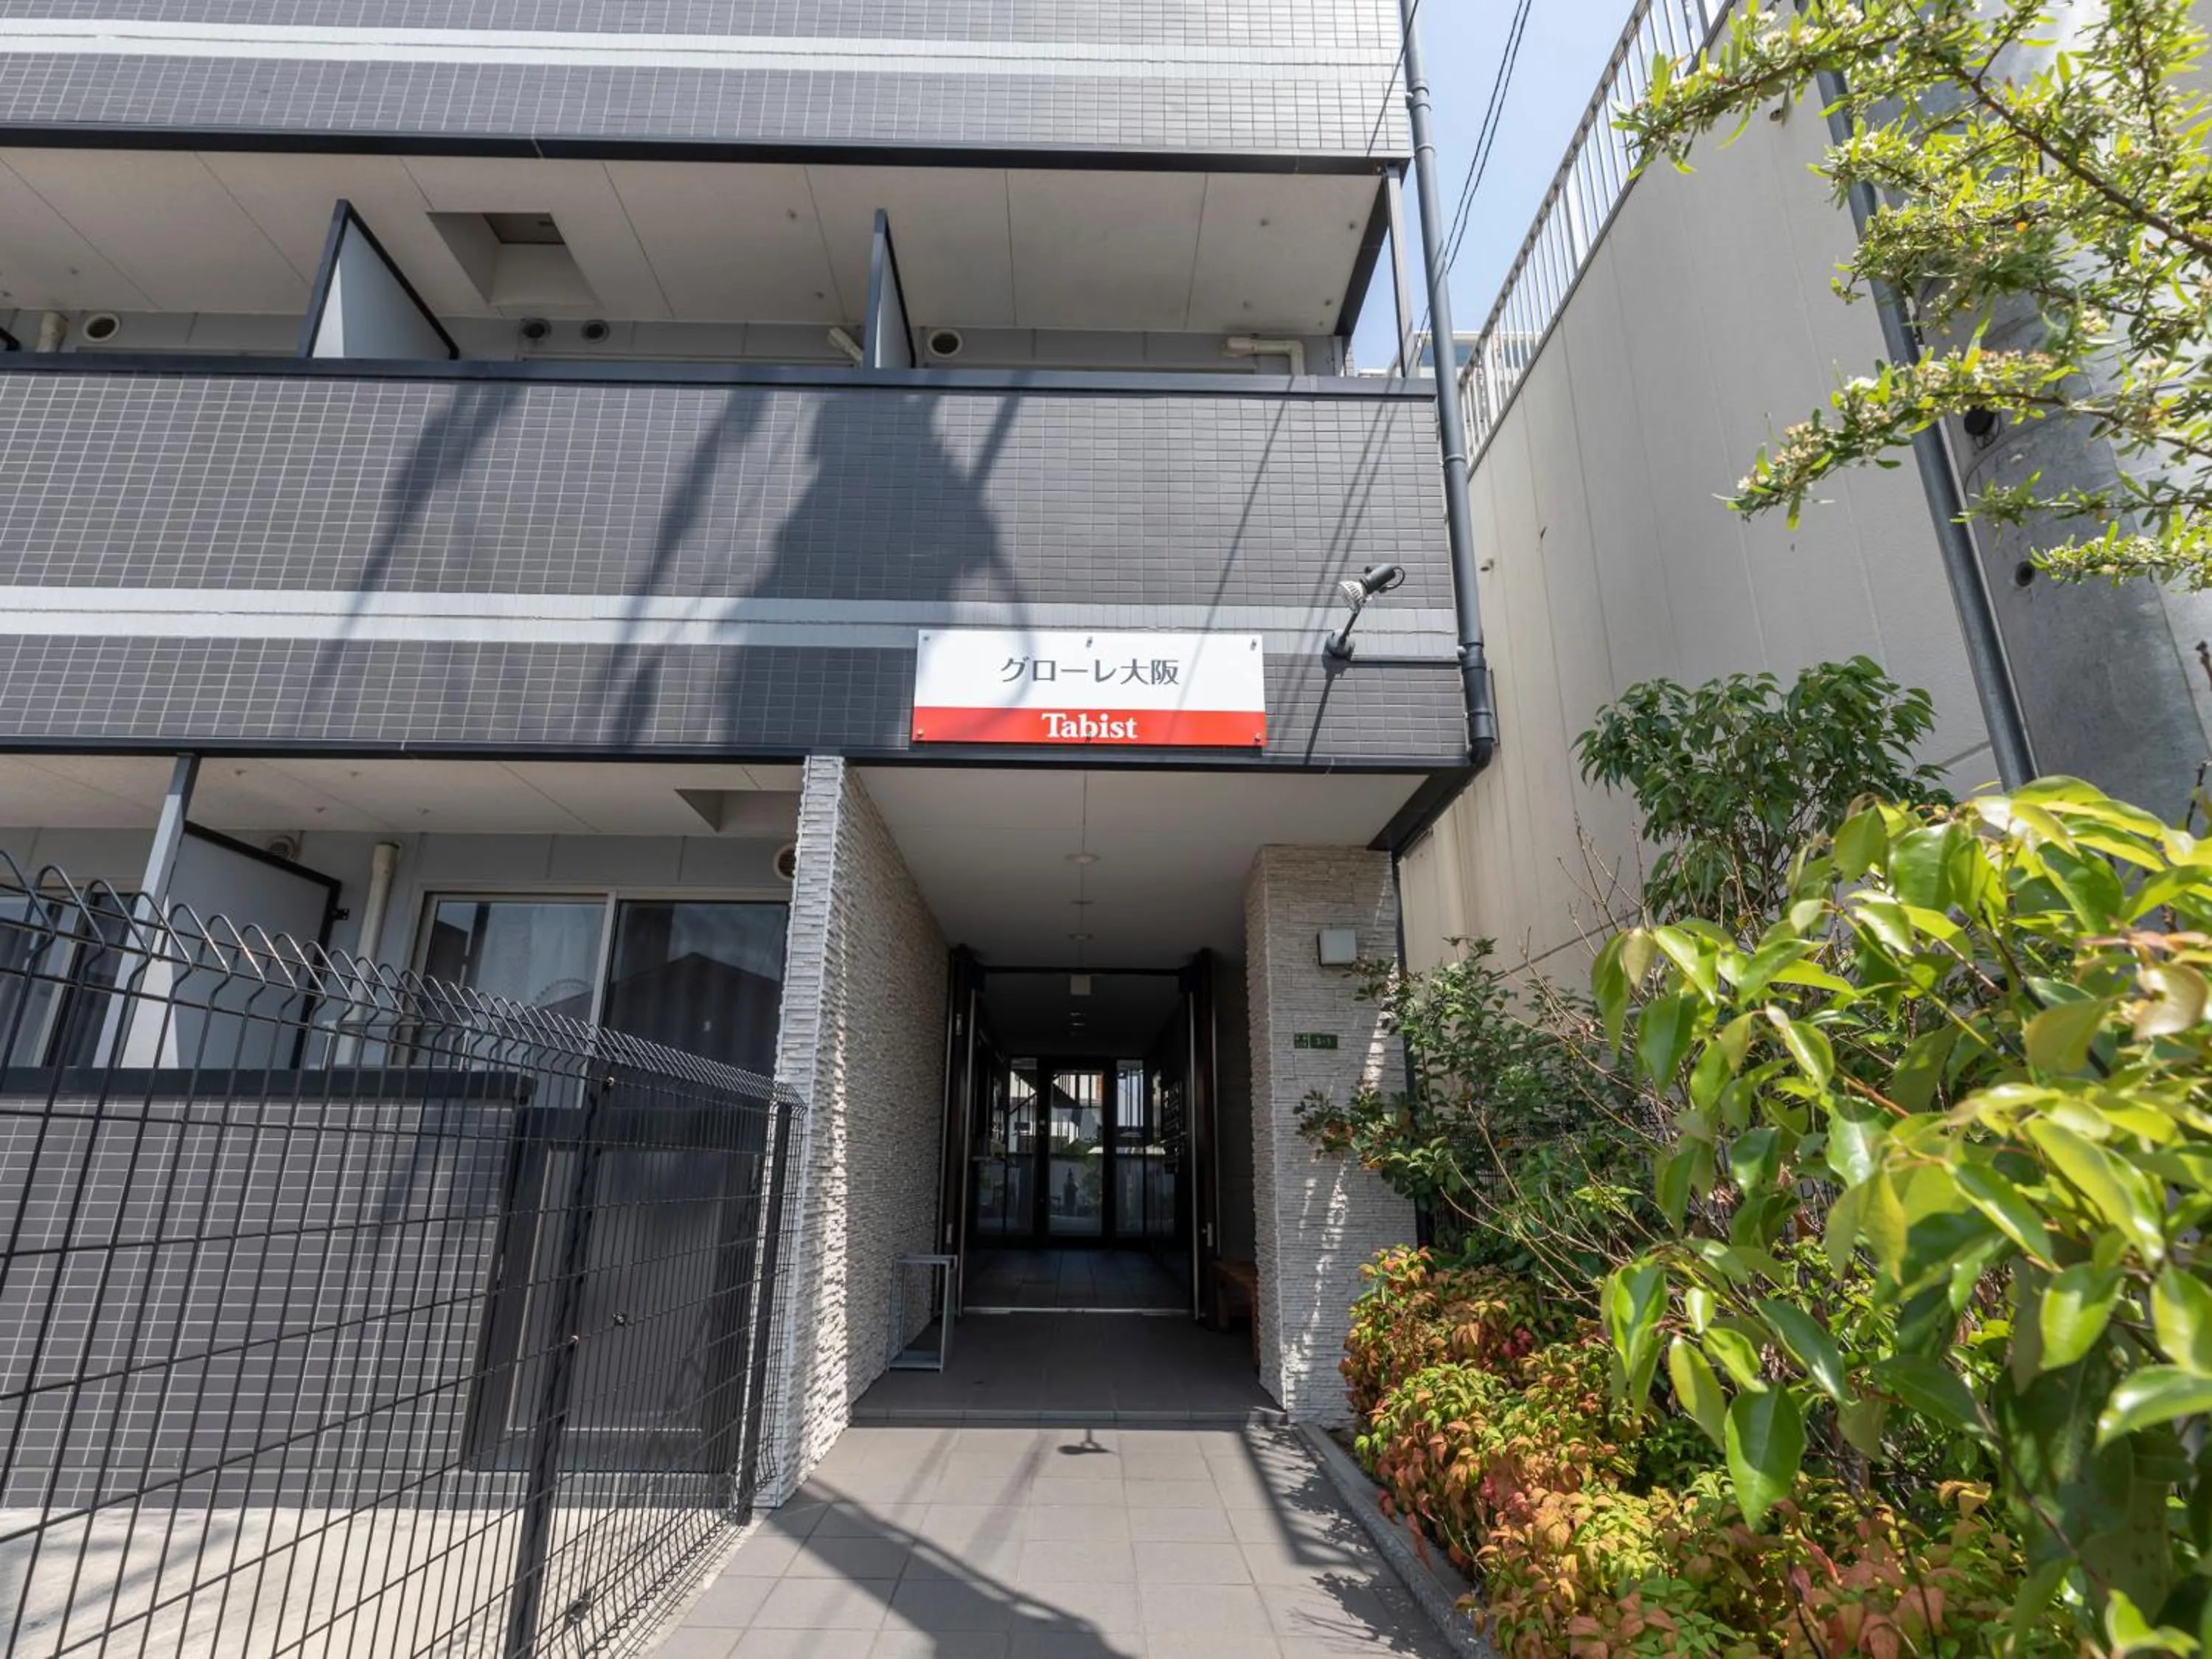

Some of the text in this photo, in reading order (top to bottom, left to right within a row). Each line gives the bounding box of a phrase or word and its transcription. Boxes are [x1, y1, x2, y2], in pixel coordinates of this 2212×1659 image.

[1001, 656, 1179, 685] グローレ大阪
[1041, 712, 1137, 739] Tabist
